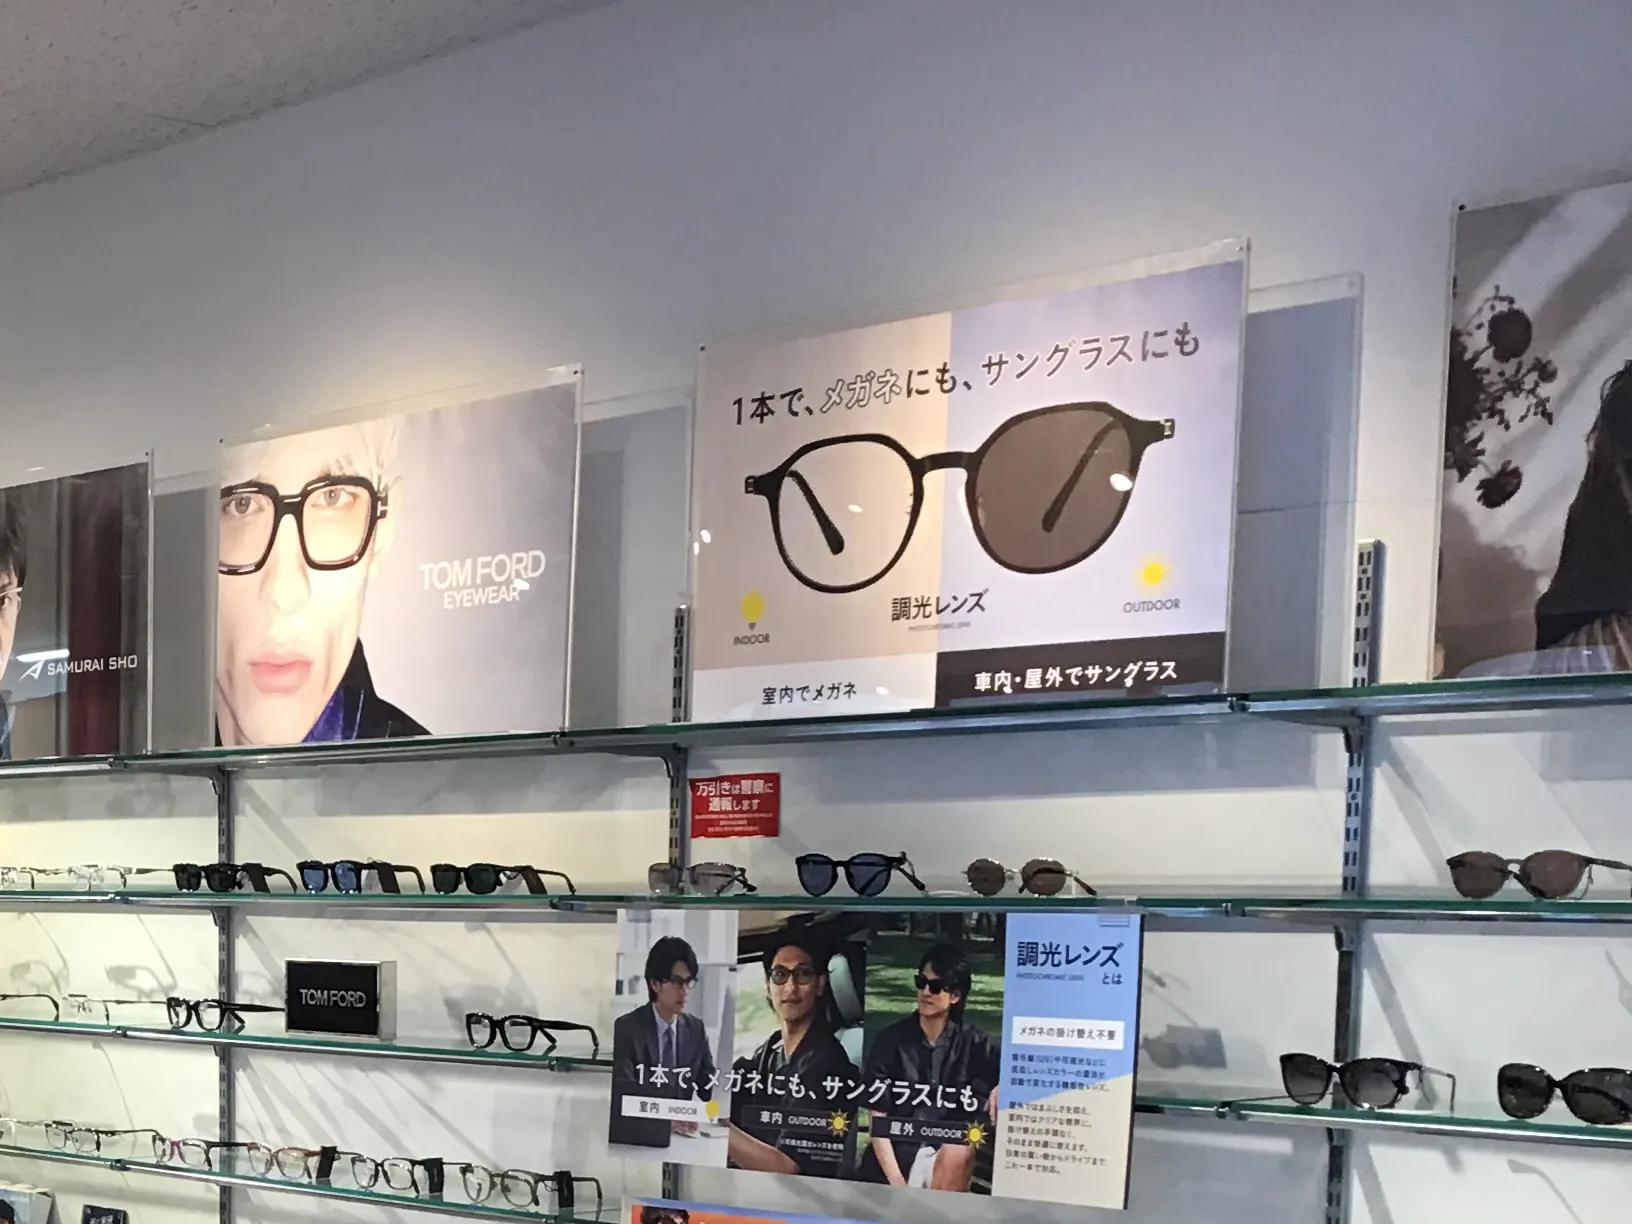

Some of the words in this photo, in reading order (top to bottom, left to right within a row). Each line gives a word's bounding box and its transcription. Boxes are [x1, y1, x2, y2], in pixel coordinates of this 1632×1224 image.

[419, 559, 474, 591] TOM
[476, 550, 546, 585] FORD
[443, 585, 521, 610] EYEWEAR
[891, 588, 990, 623] 調光レンズ
[1122, 598, 1181, 614] OUTDOOR
[733, 633, 771, 646] INDOOR
[46, 656, 104, 677] SAMURAI
[108, 654, 138, 670] SHO
[973, 659, 1178, 694] 車内・屋外でサングラス
[761, 682, 858, 706] 室内でメガネ
[1016, 941, 1124, 968] 調光レンズ
[1101, 972, 1123, 986] とは
[298, 988, 328, 1006] TOM
[330, 990, 367, 1008] FORD
[1019, 1025, 1117, 1041] メガネの掛け替え不要
[635, 1062, 980, 1112] 1本で、メガネにも、サングラスにも
[638, 1099, 660, 1115] 室内
[759, 1110, 783, 1126] 車内
[788, 1114, 827, 1129] OUTDOOR
[889, 1121, 914, 1136] 屋外
[920, 1125, 962, 1140] OUTDOOR
